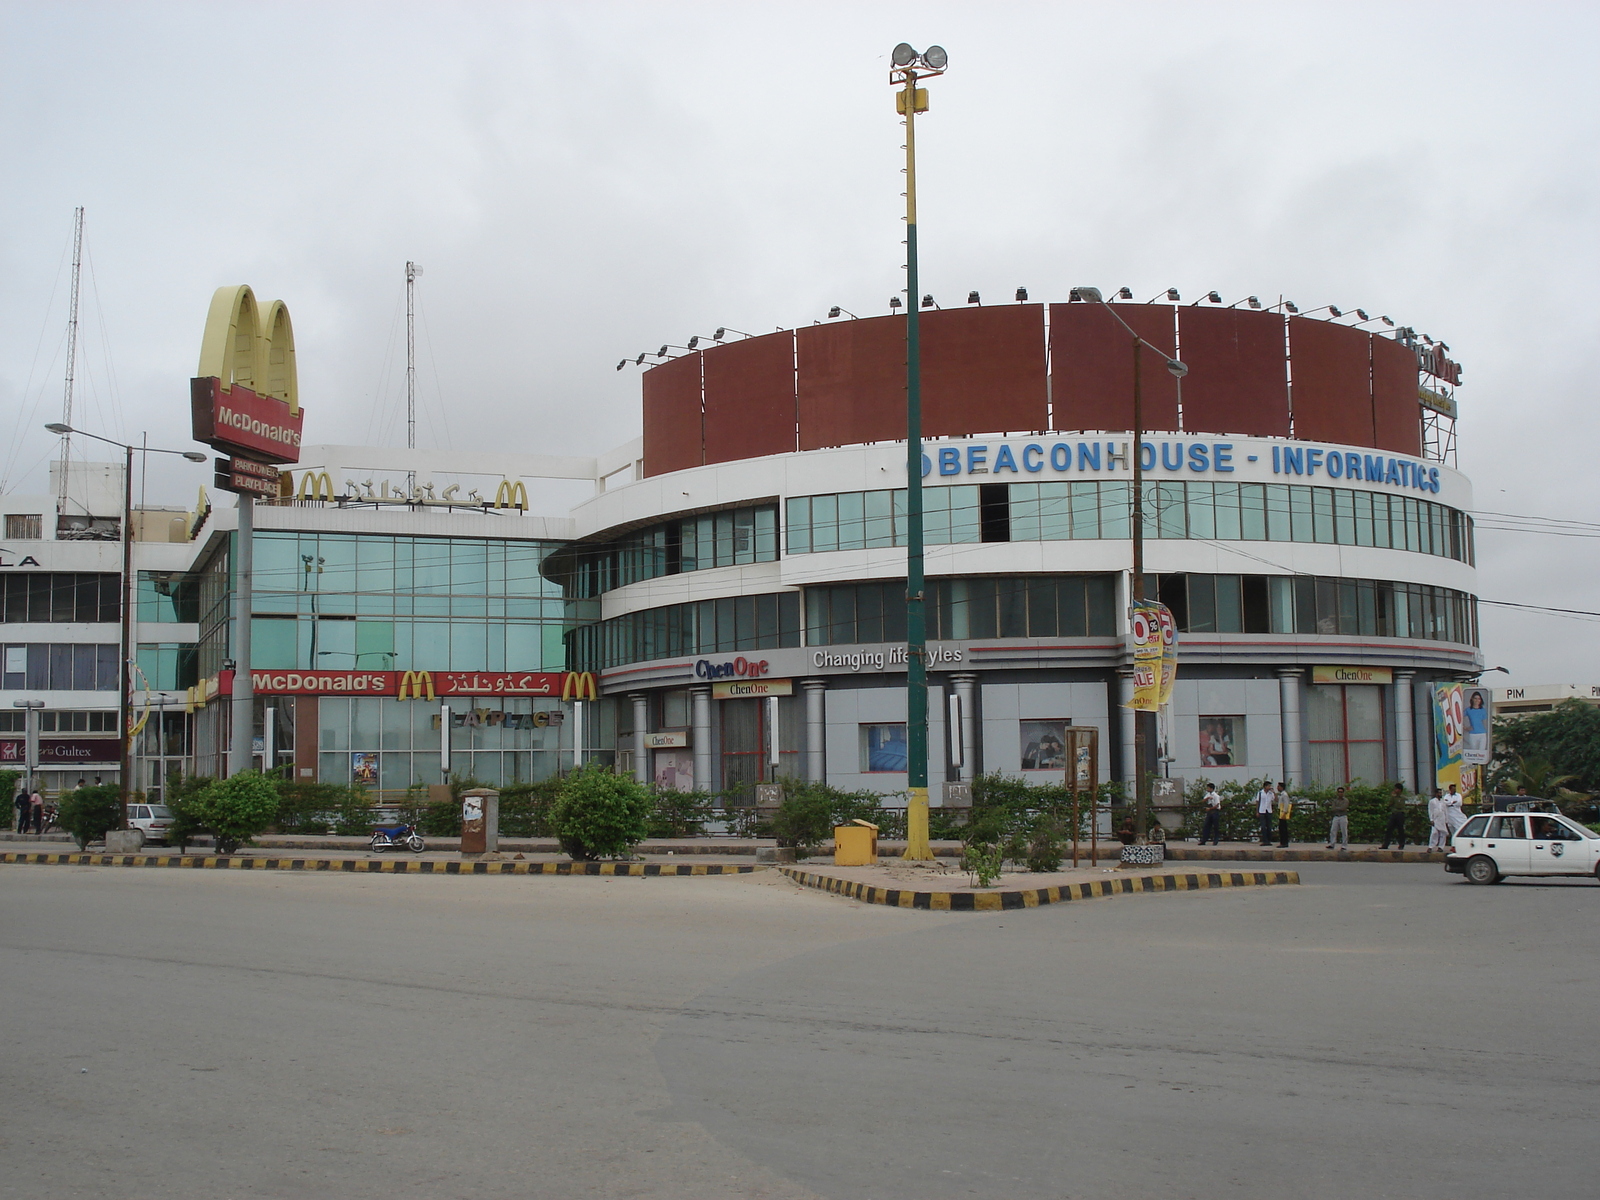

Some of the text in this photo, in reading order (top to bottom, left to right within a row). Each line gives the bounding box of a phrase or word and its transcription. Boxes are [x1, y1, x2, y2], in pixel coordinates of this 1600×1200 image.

[218, 406, 301, 448] McDonald's
[938, 441, 1235, 476] BEACONHOUSE
[1272, 446, 1441, 494] INFORMATICS
[813, 646, 962, 672] Changing lifeyles
[695, 656, 769, 680] ChenOne
[1335, 668, 1373, 681] ChenOne
[251, 673, 386, 692] McDonald's
[1133, 672, 1154, 687] ALE
[729, 682, 769, 695] ChenOne
[1506, 688, 1525, 699] PIM
[1591, 685, 1600, 697] PI
[55, 745, 92, 757] Gultex
